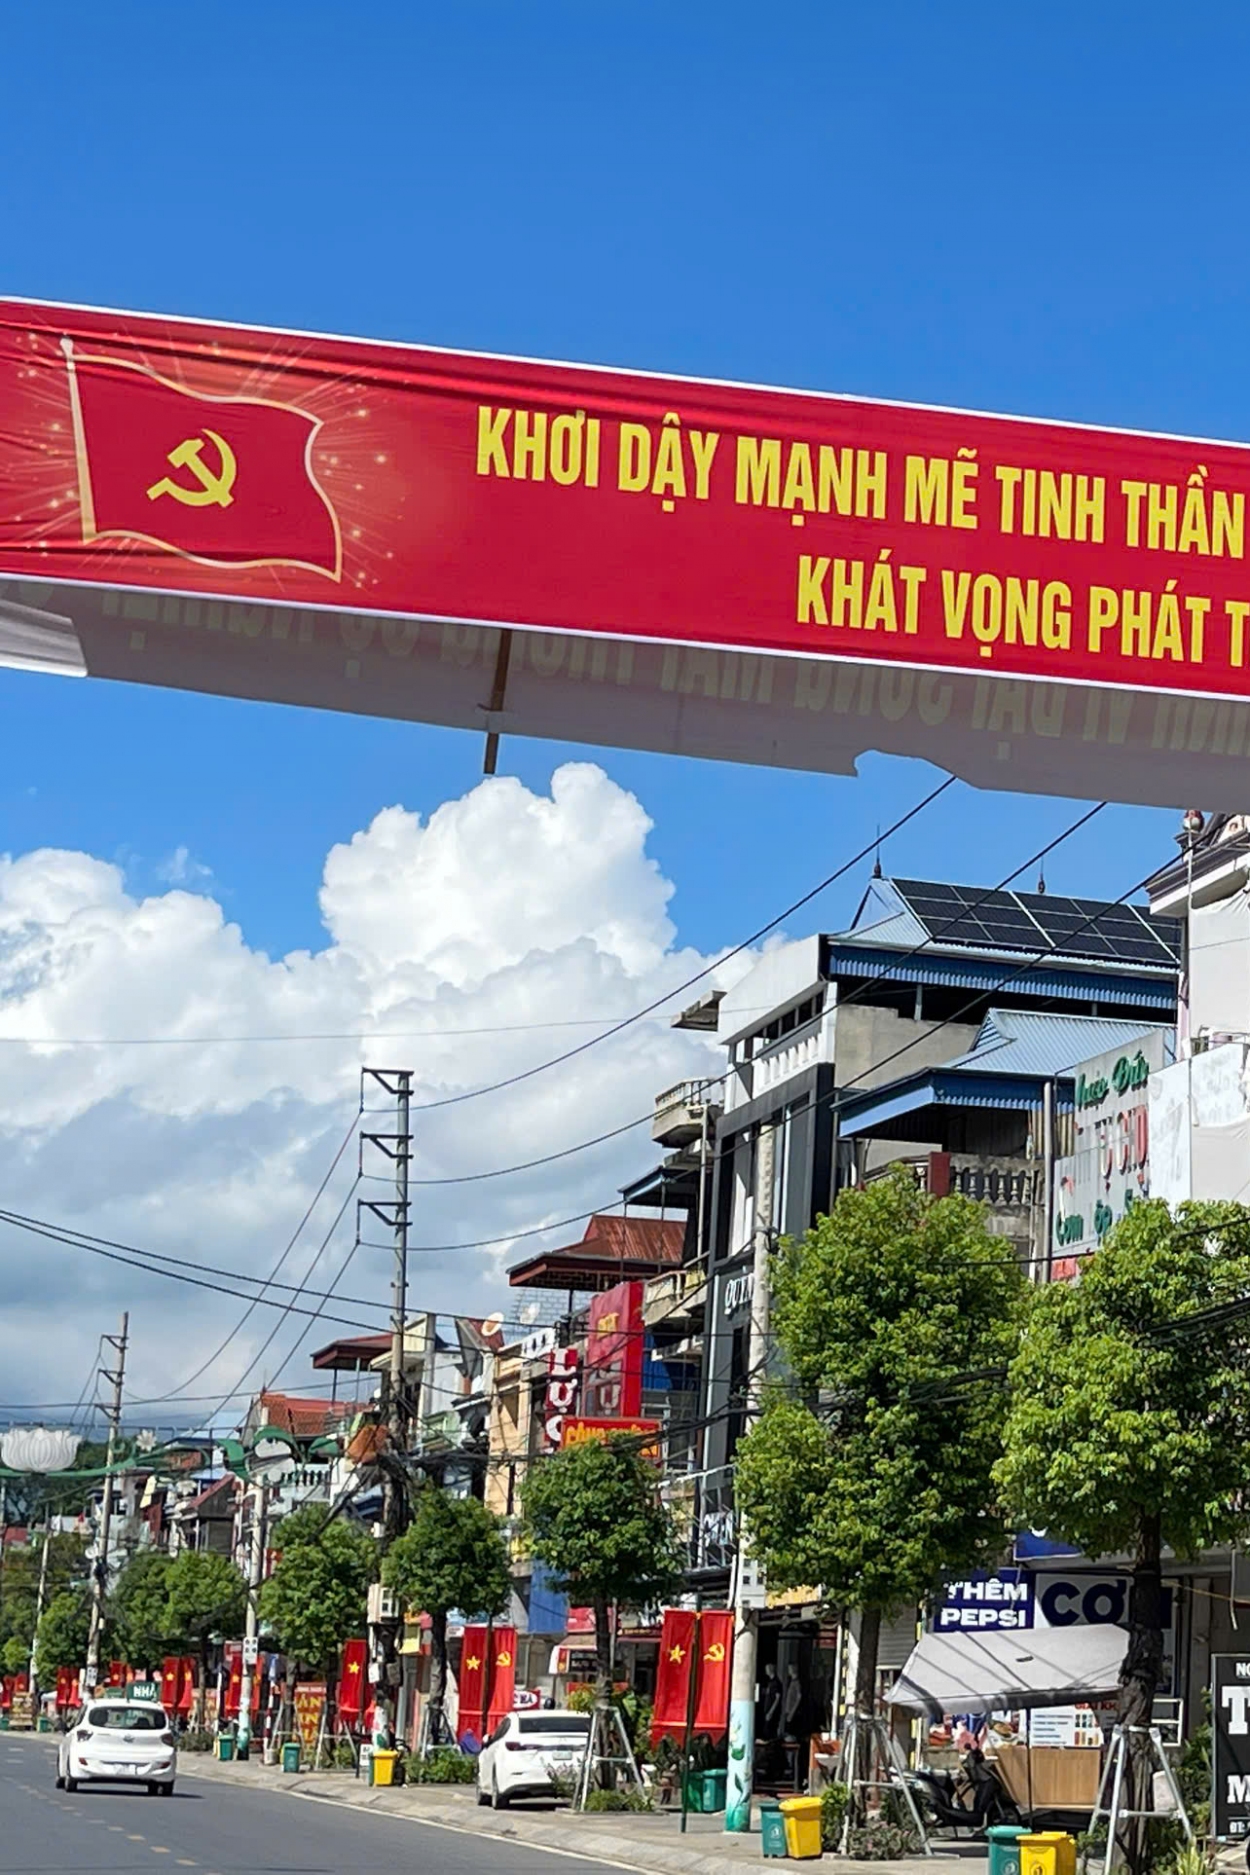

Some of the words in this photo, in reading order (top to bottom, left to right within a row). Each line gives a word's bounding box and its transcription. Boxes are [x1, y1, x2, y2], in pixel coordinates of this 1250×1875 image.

[477, 404, 600, 487] KHƠI
[619, 412, 720, 512] DẬY
[736, 436, 887, 527] MẠNH
[905, 447, 979, 529] MẼ
[996, 465, 1106, 543] TINH
[1122, 464, 1245, 559] THẦN
[798, 549, 927, 634] KHÁT
[942, 570, 1072, 658] VỌNG
[1089, 579, 1211, 663] PHÁT
[940, 1608, 1026, 1627] PEPSI
[946, 1578, 1028, 1601] THÊM
